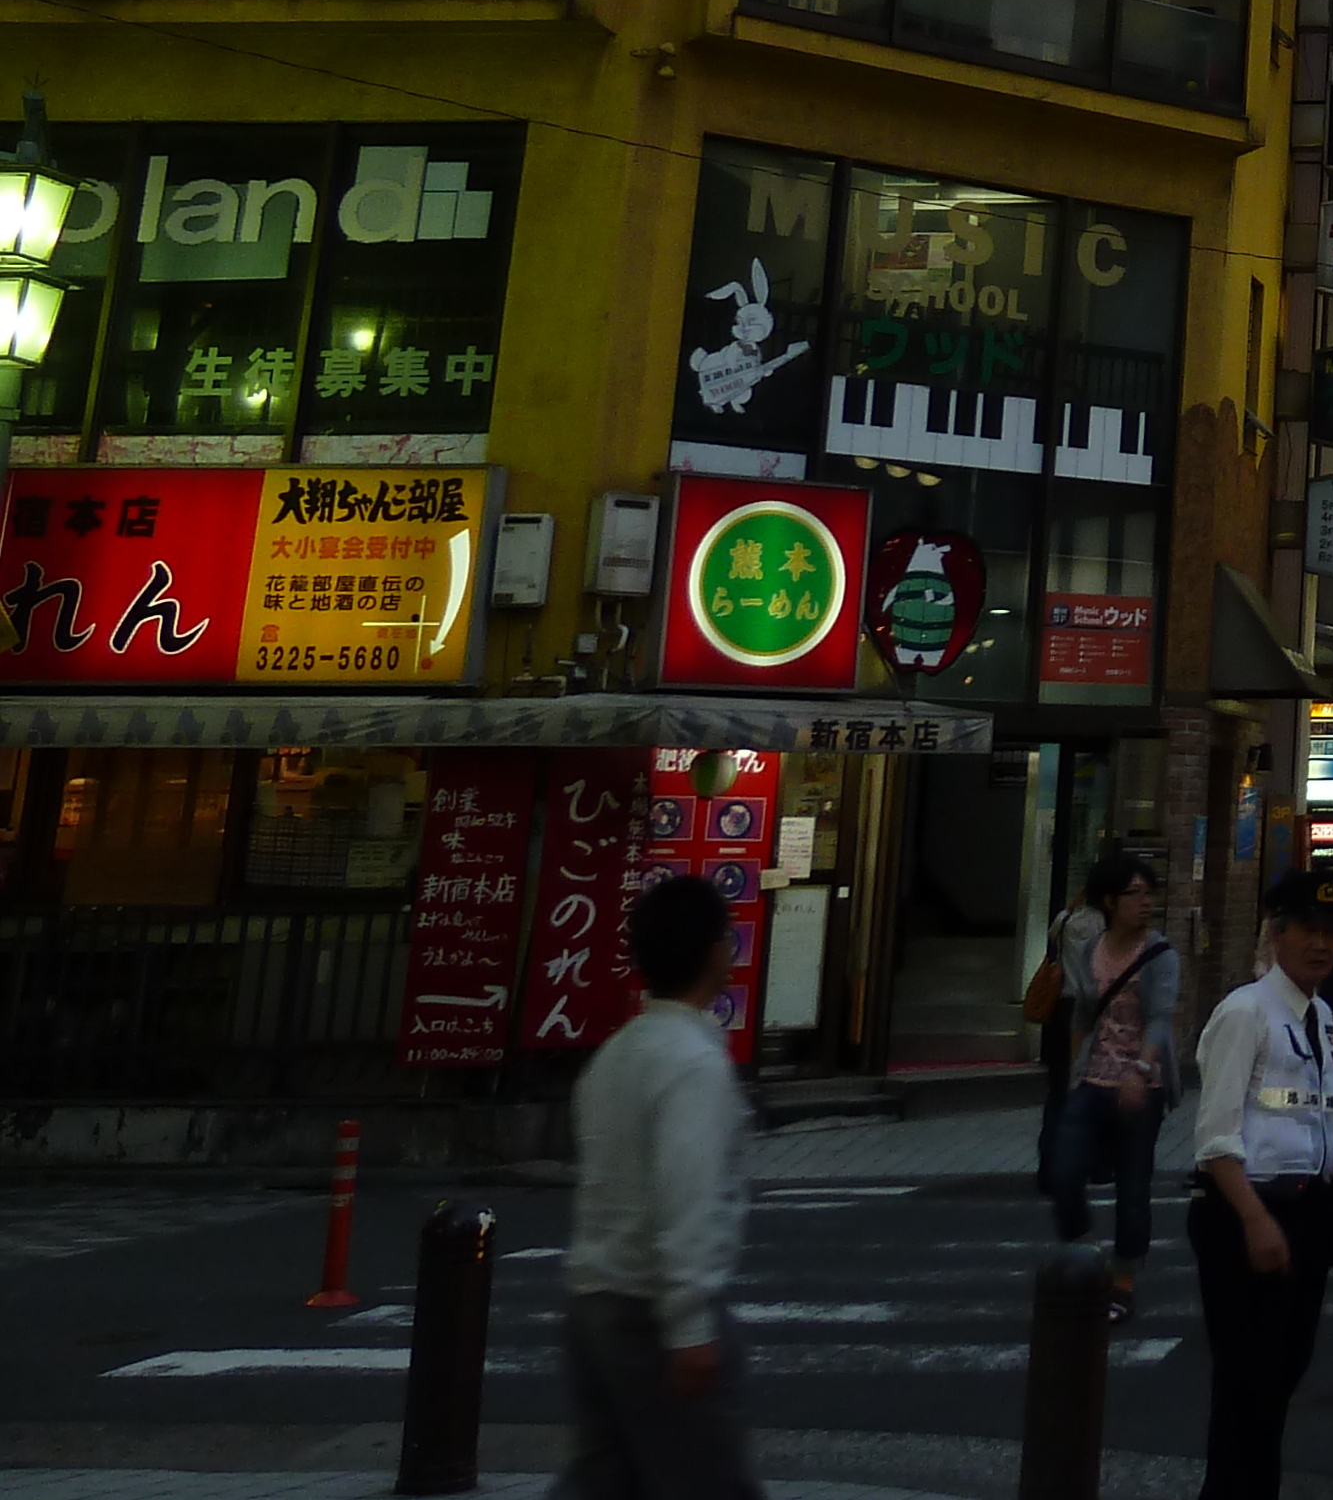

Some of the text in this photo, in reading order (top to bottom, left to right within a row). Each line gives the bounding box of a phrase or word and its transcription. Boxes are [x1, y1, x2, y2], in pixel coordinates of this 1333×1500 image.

[745, 166, 1128, 289] MUSIC
[860, 314, 1025, 383] ウッド
[180, 344, 496, 400] 生徒募集中
[270, 535, 436, 561] 大小宴会受付中
[728, 539, 818, 581] 熊本
[264, 574, 425, 594] 花籠部屋直伝の
[263, 593, 402, 612] 味と地酒の店
[711, 586, 821, 622] らーめん
[1104, 606, 1148, 627] ウッド
[255, 645, 400, 672] 3225-5680
[810, 719, 941, 753] 新宿本店
[440, 829, 466, 851] 味
[420, 872, 518, 906] 新宿本店
[535, 776, 622, 1041] ひごのれん
